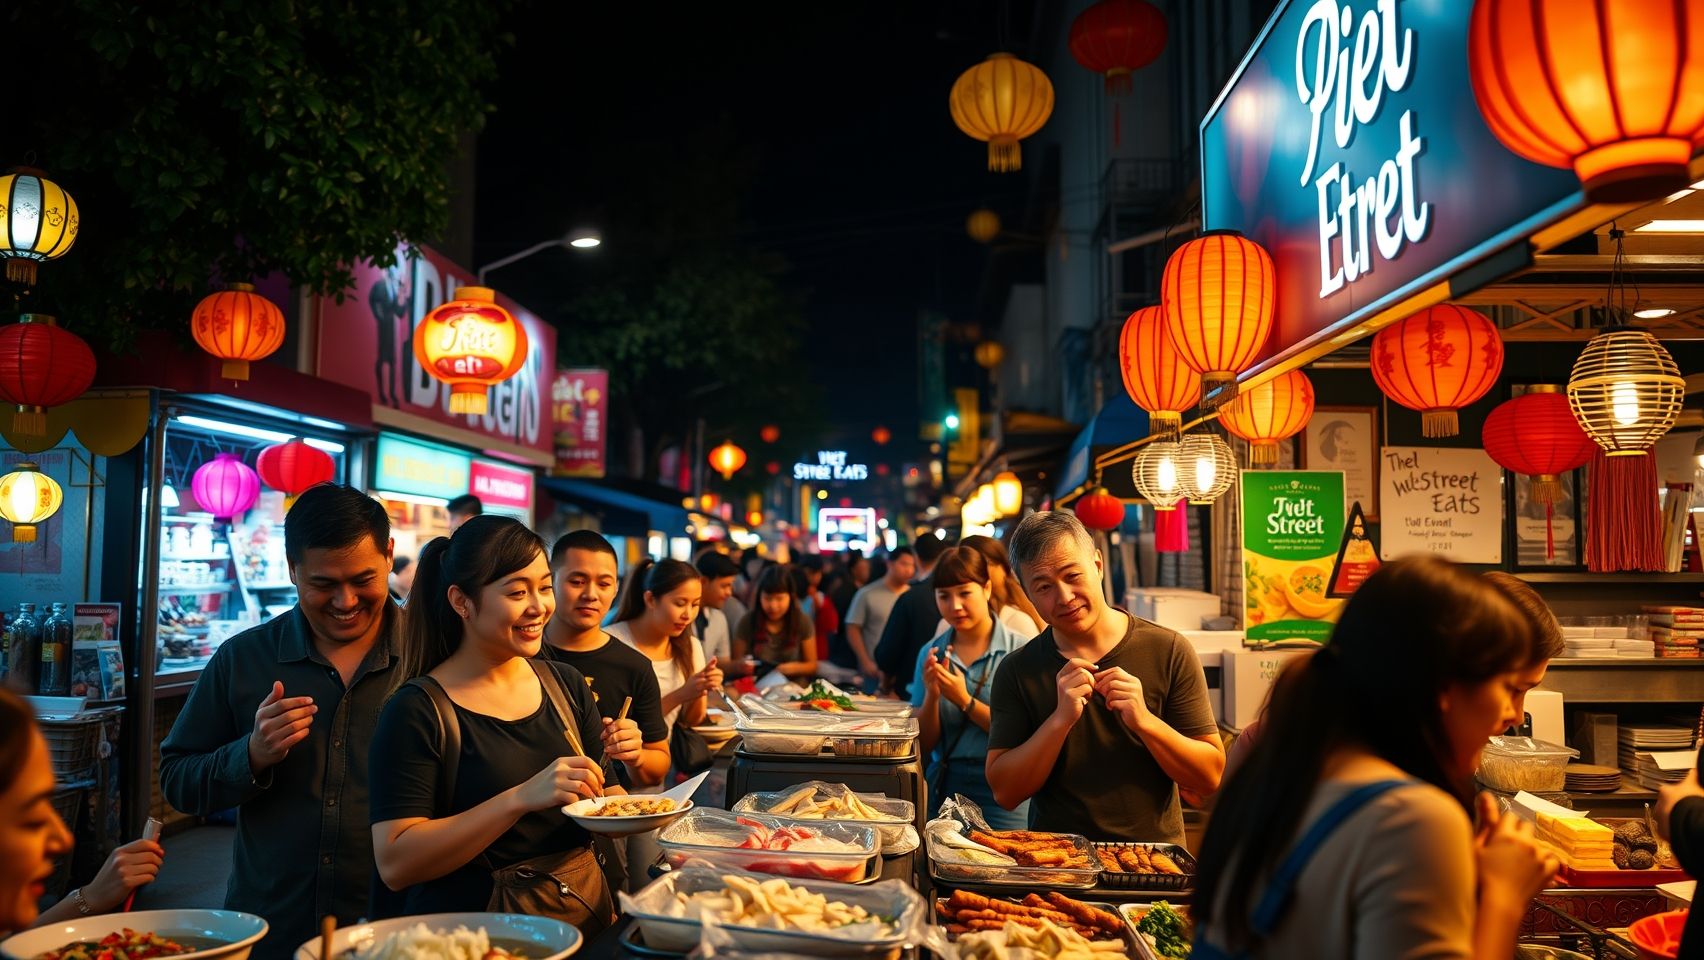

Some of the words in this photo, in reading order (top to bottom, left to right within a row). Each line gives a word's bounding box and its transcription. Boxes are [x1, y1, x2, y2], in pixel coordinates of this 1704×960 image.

[1316, 110, 1428, 299] Etret
[1431, 493, 1480, 514] Eats
[1266, 513, 1325, 535] Street
